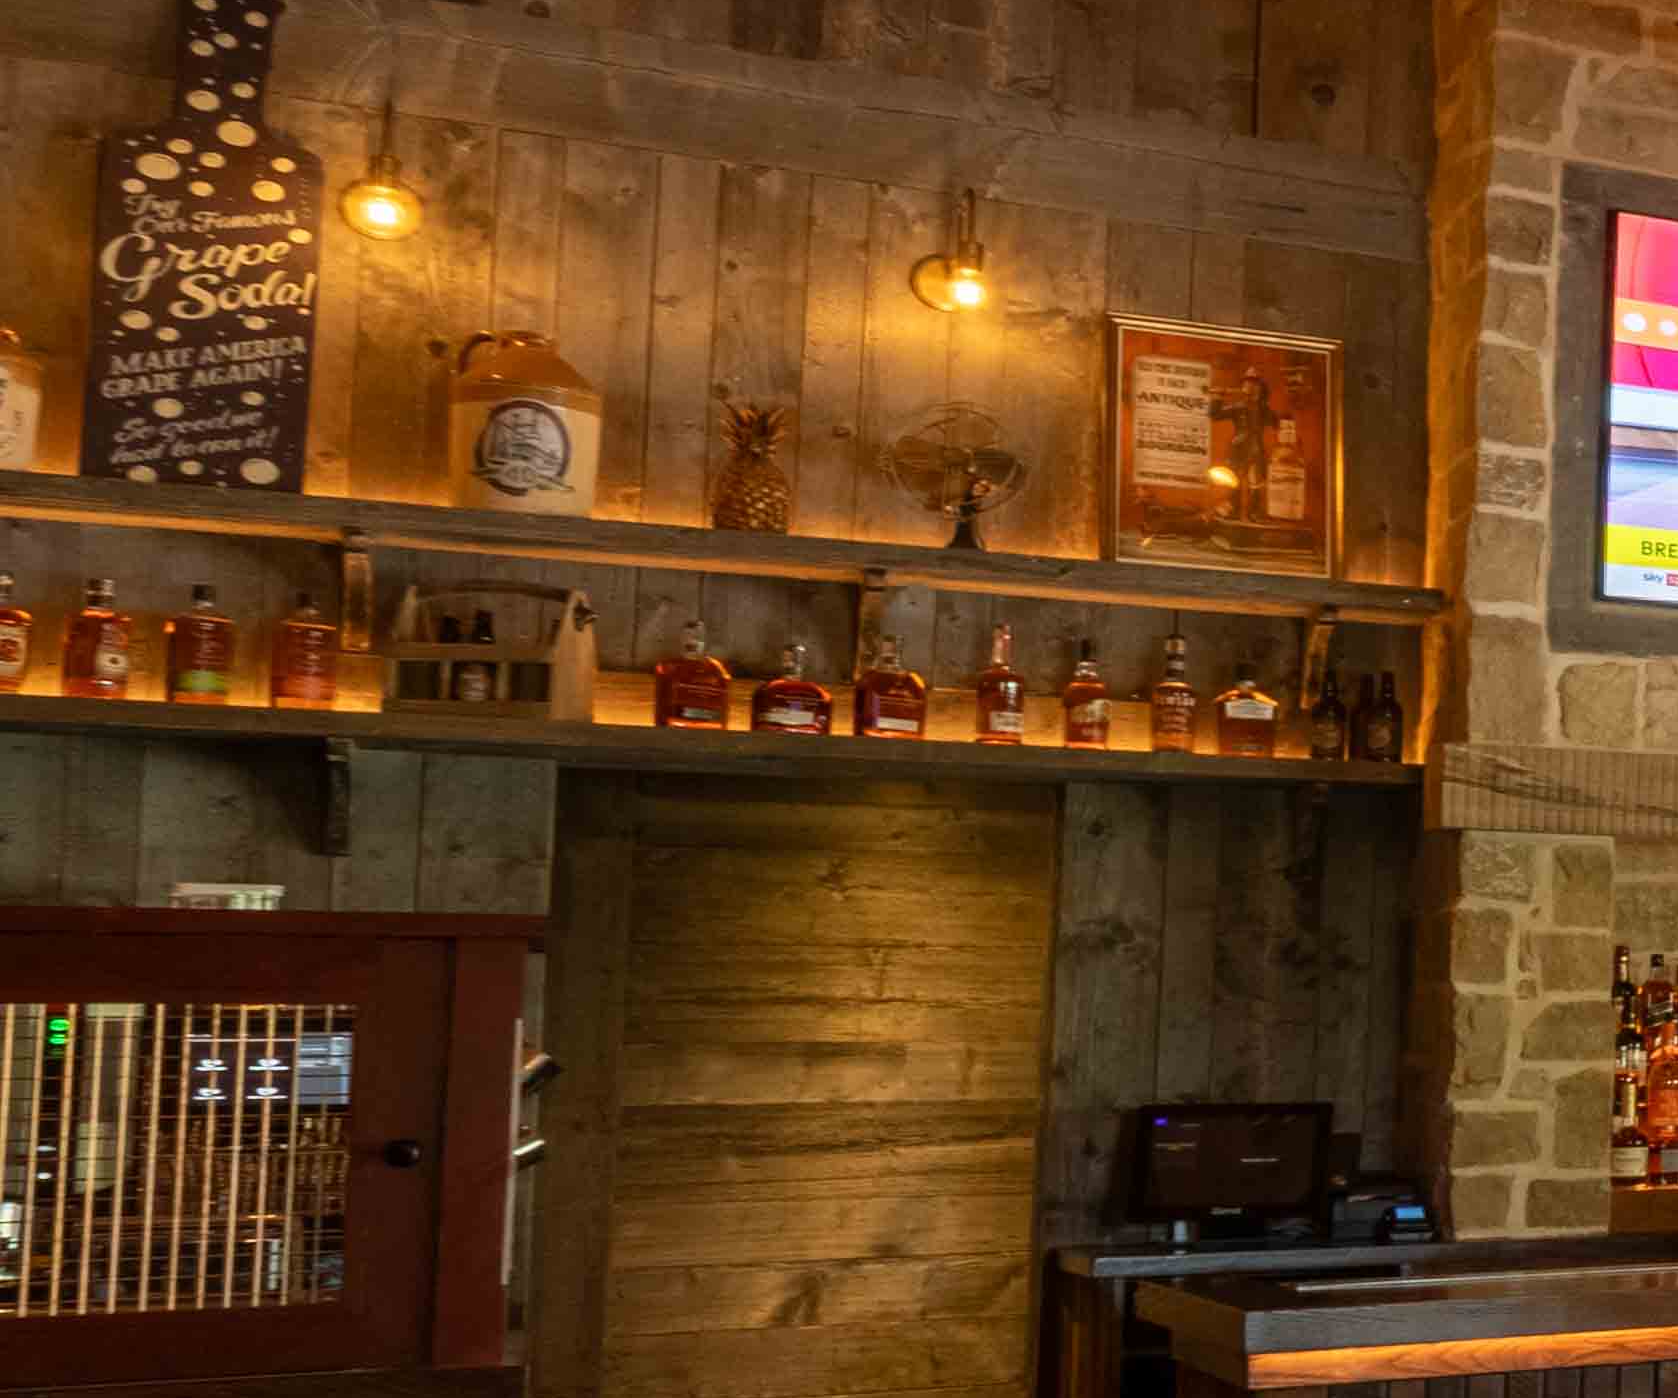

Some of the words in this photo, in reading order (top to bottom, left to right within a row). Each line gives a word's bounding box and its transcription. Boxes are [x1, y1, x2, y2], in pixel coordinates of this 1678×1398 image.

[191, 210, 296, 233] Famous
[100, 233, 291, 302] Grape
[167, 270, 317, 320] Soda!
[111, 346, 197, 375] MAKE
[200, 335, 308, 364] AMERICA
[191, 359, 285, 387] AGAIN!
[1136, 391, 1207, 410] ANTIQUE
